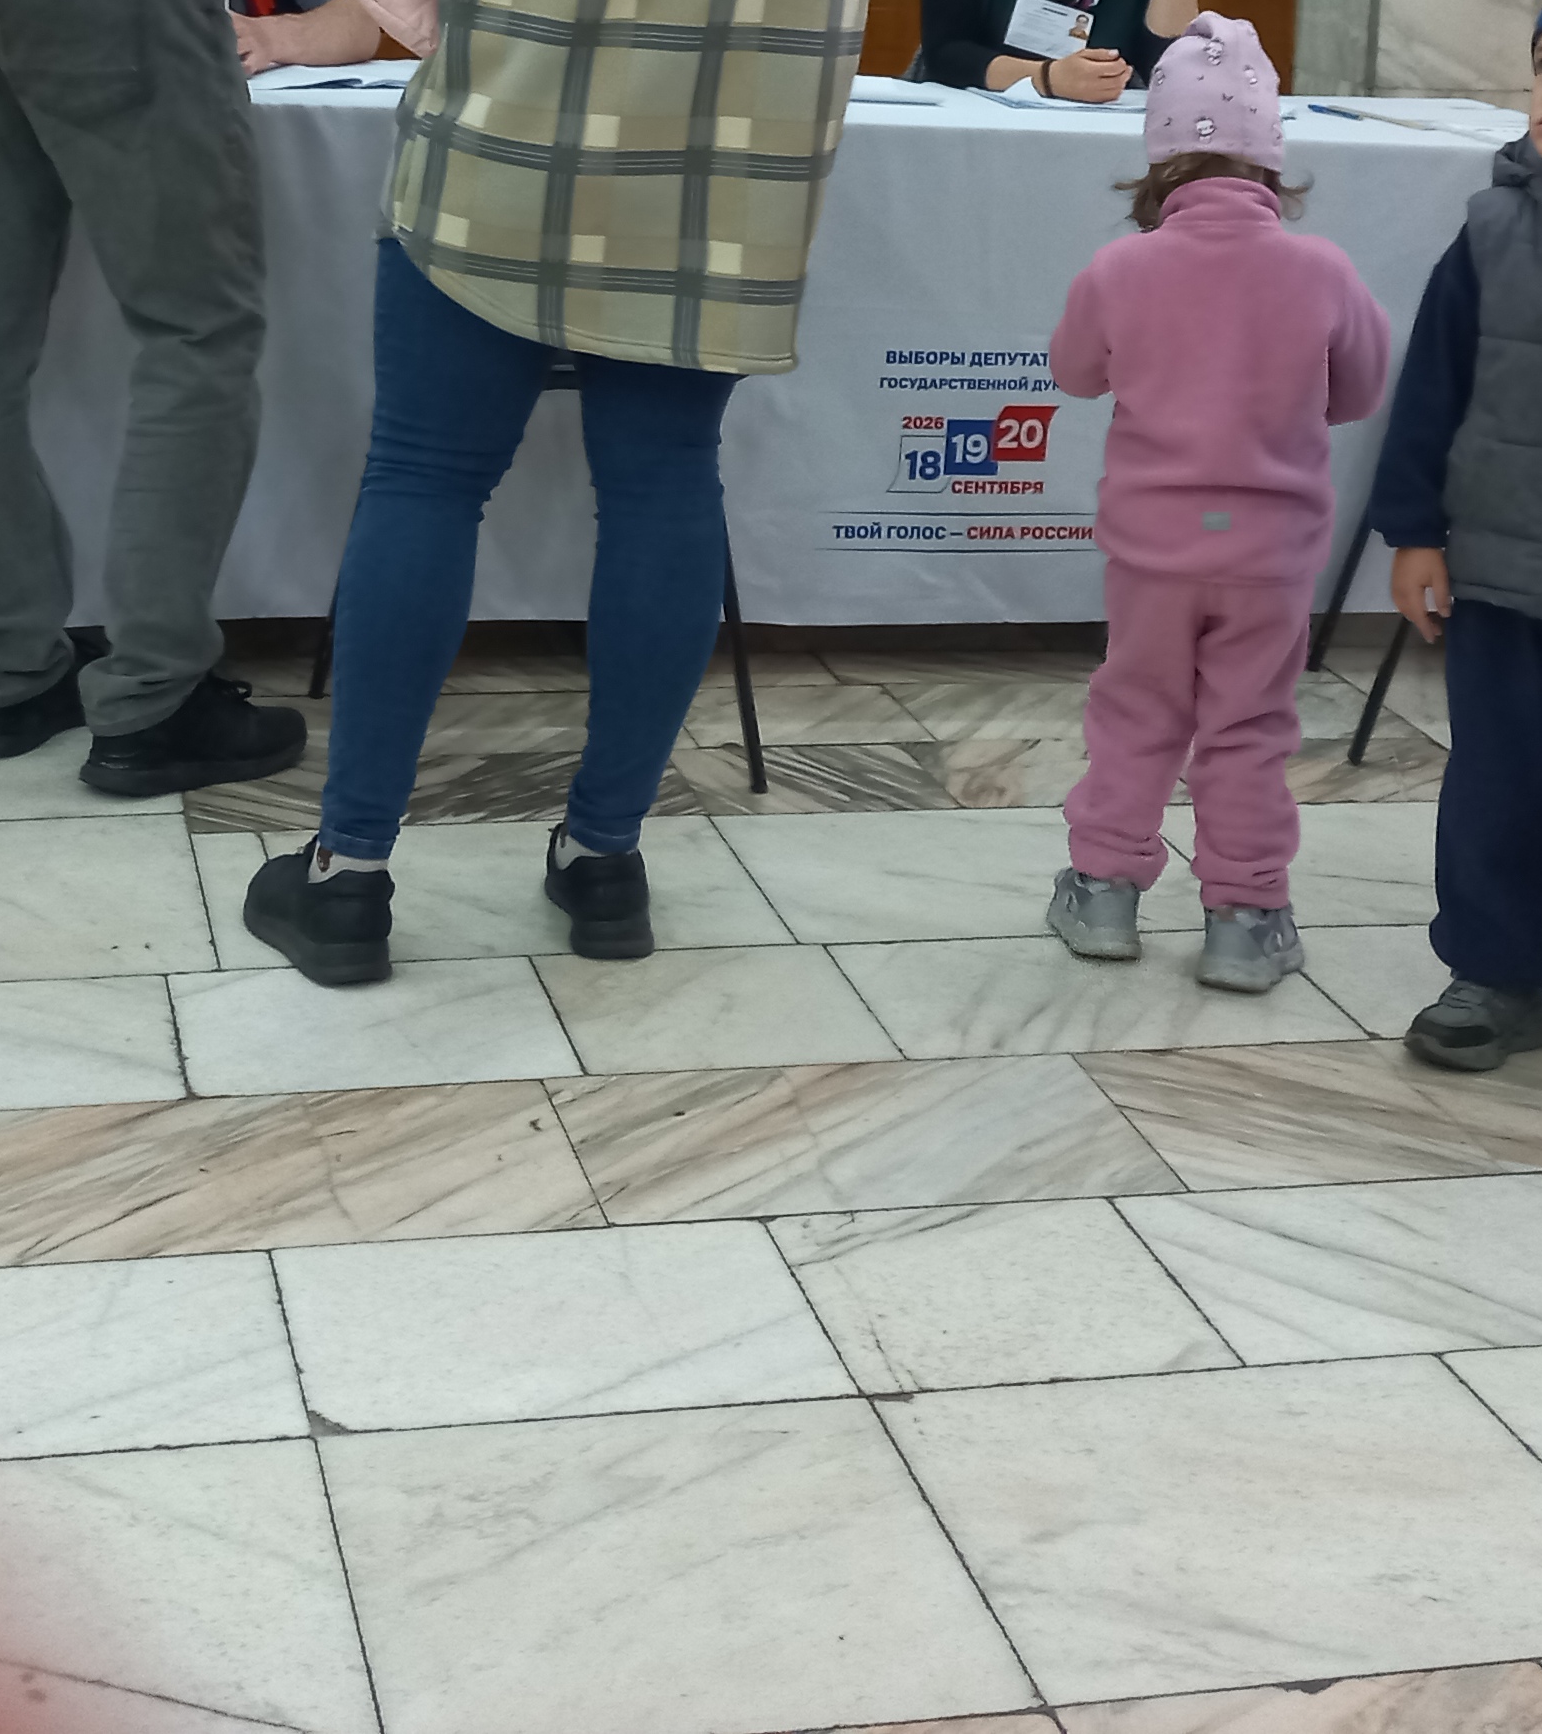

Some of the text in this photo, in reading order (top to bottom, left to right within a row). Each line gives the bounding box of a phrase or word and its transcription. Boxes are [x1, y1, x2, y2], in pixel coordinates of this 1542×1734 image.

[885, 350, 1049, 368] ВЫБОРЫ ДЕПУТАТ
[879, 376, 1029, 392] ГОСУДАРСТВЕННОЙ
[901, 415, 945, 430] 2026
[904, 418, 1045, 480] 18 19 20
[951, 480, 1045, 495] СЕНТЯБРЯ
[832, 521, 882, 540] ТВОЙ
[886, 525, 947, 541] ГОЛОС
[966, 525, 1016, 541] СИЛА
[1019, 525, 1095, 541] РОССИИ
